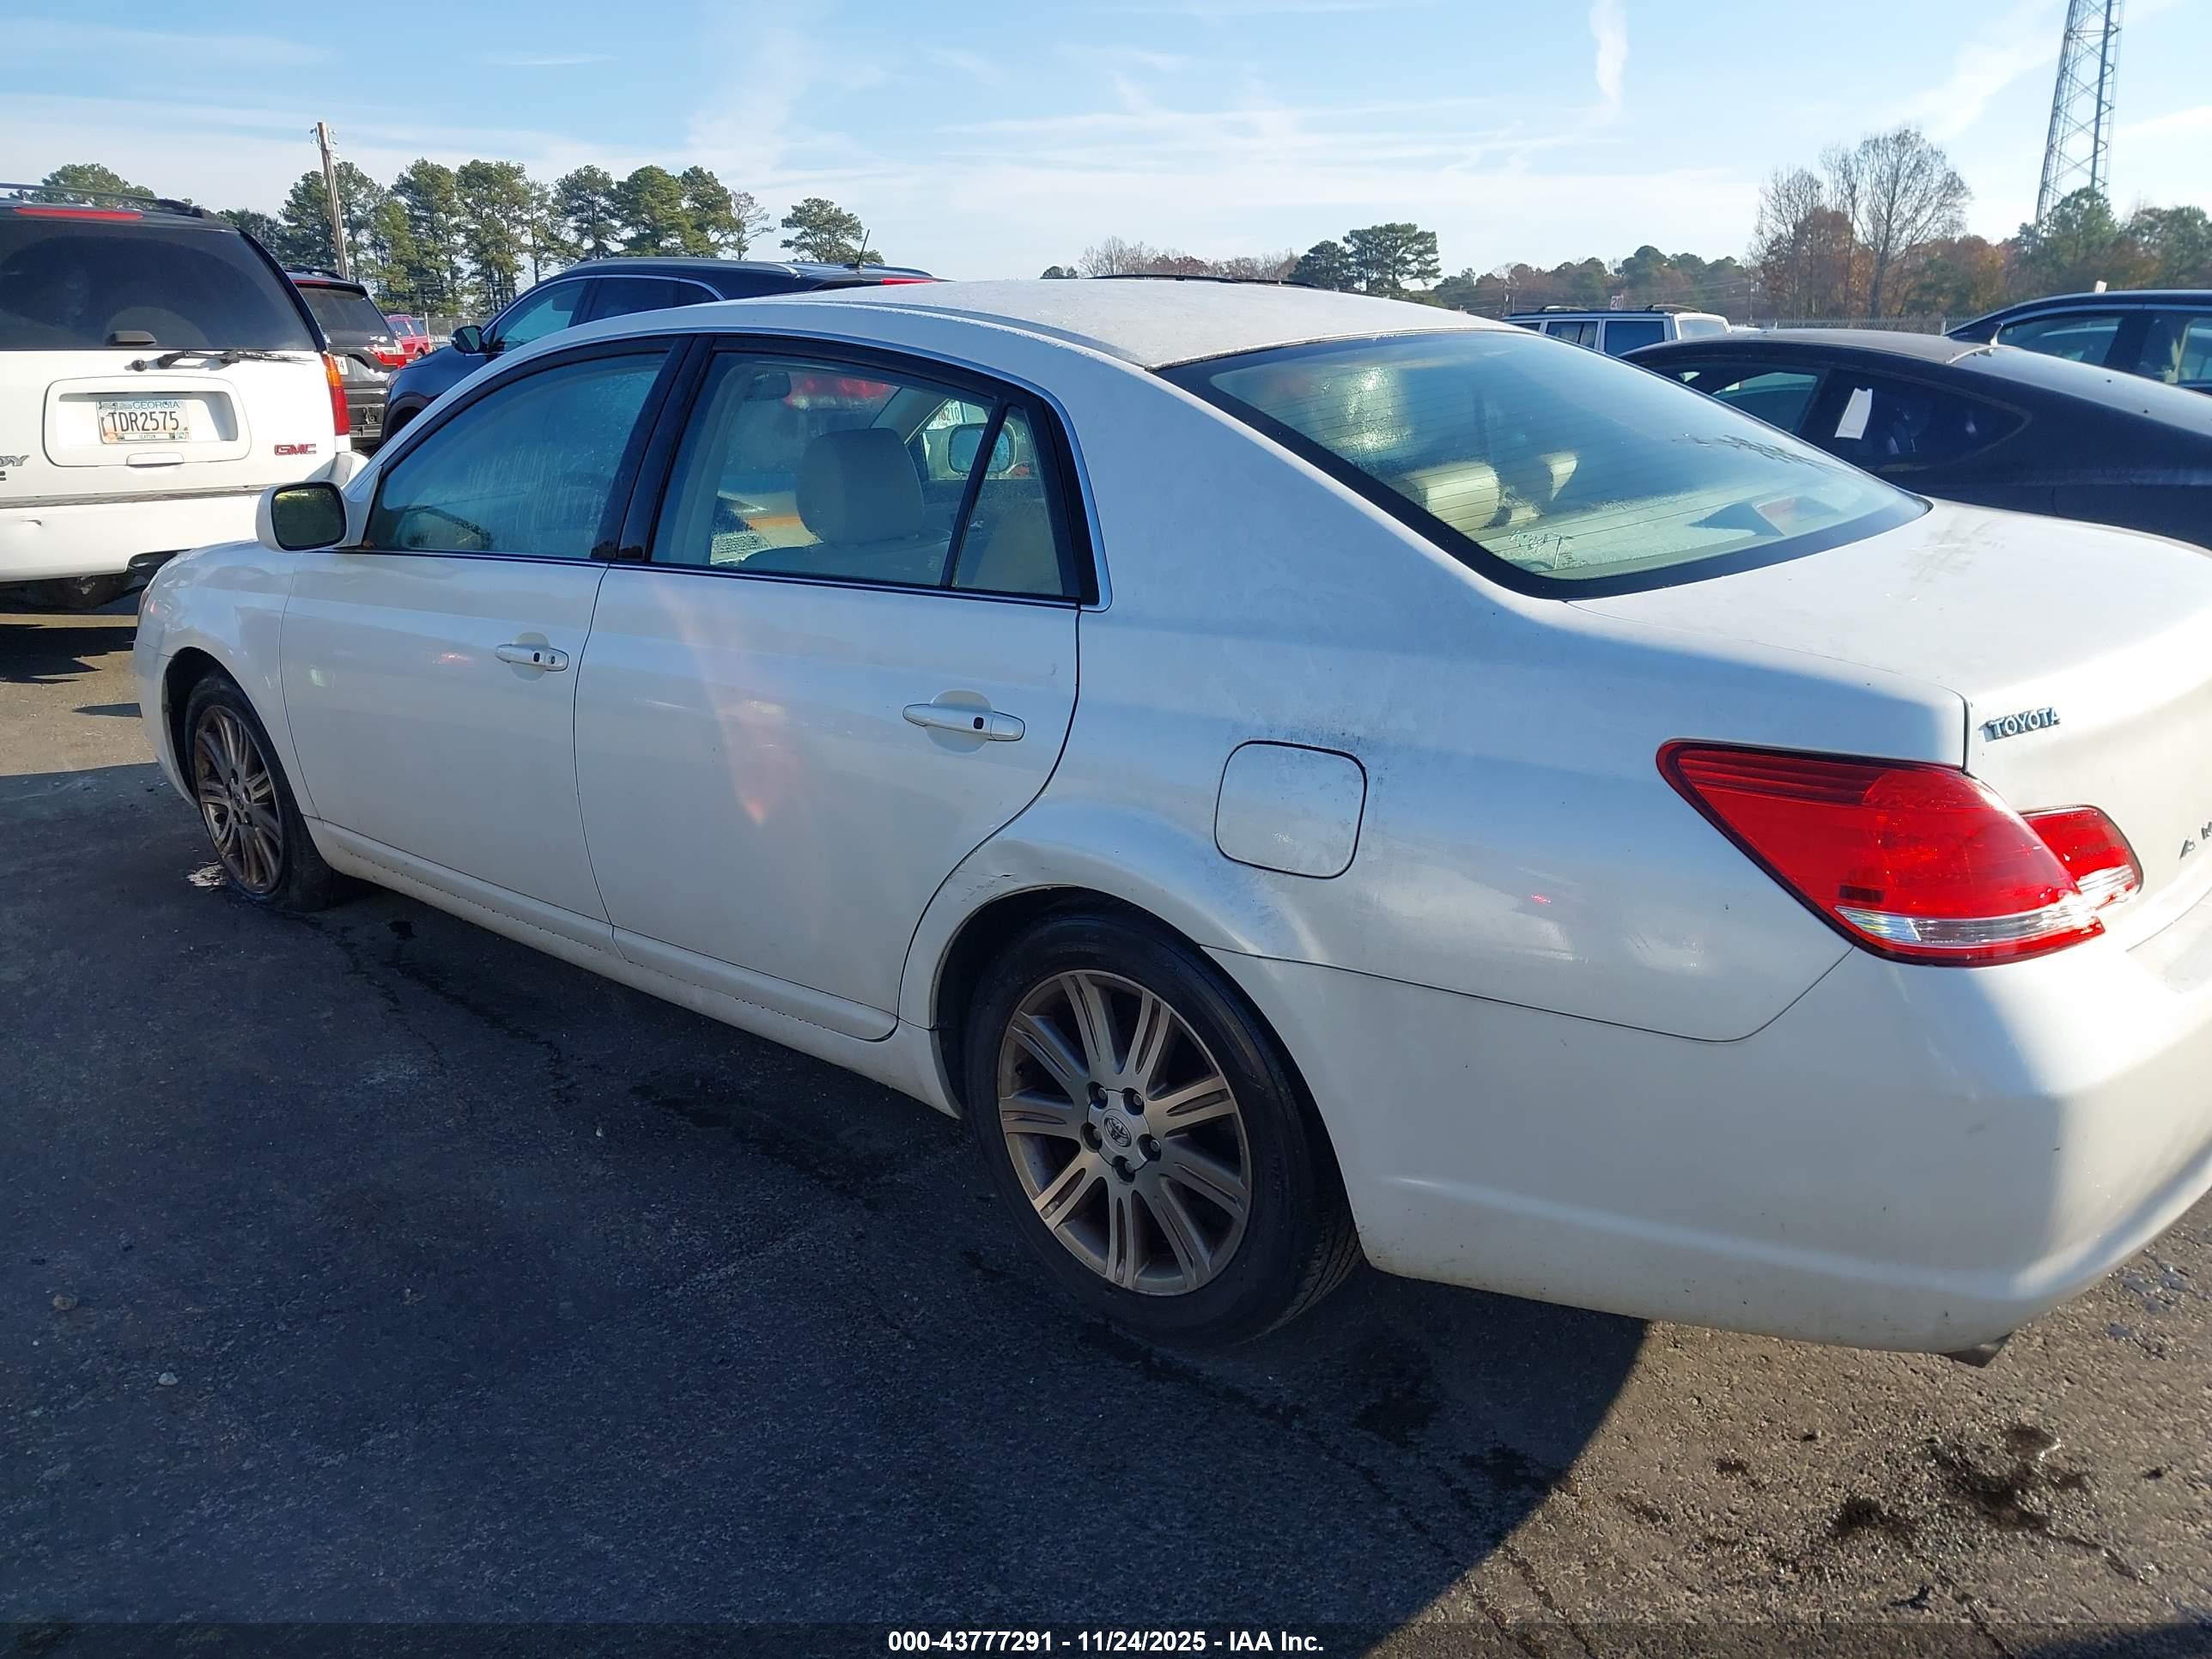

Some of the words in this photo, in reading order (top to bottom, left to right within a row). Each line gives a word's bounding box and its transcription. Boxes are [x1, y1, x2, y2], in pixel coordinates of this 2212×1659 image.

[132, 401, 180, 410] GEORGIA
[108, 411, 179, 432] TDR2575
[274, 443, 317, 455] GMC
[1982, 707, 2061, 741] TOYOTA
